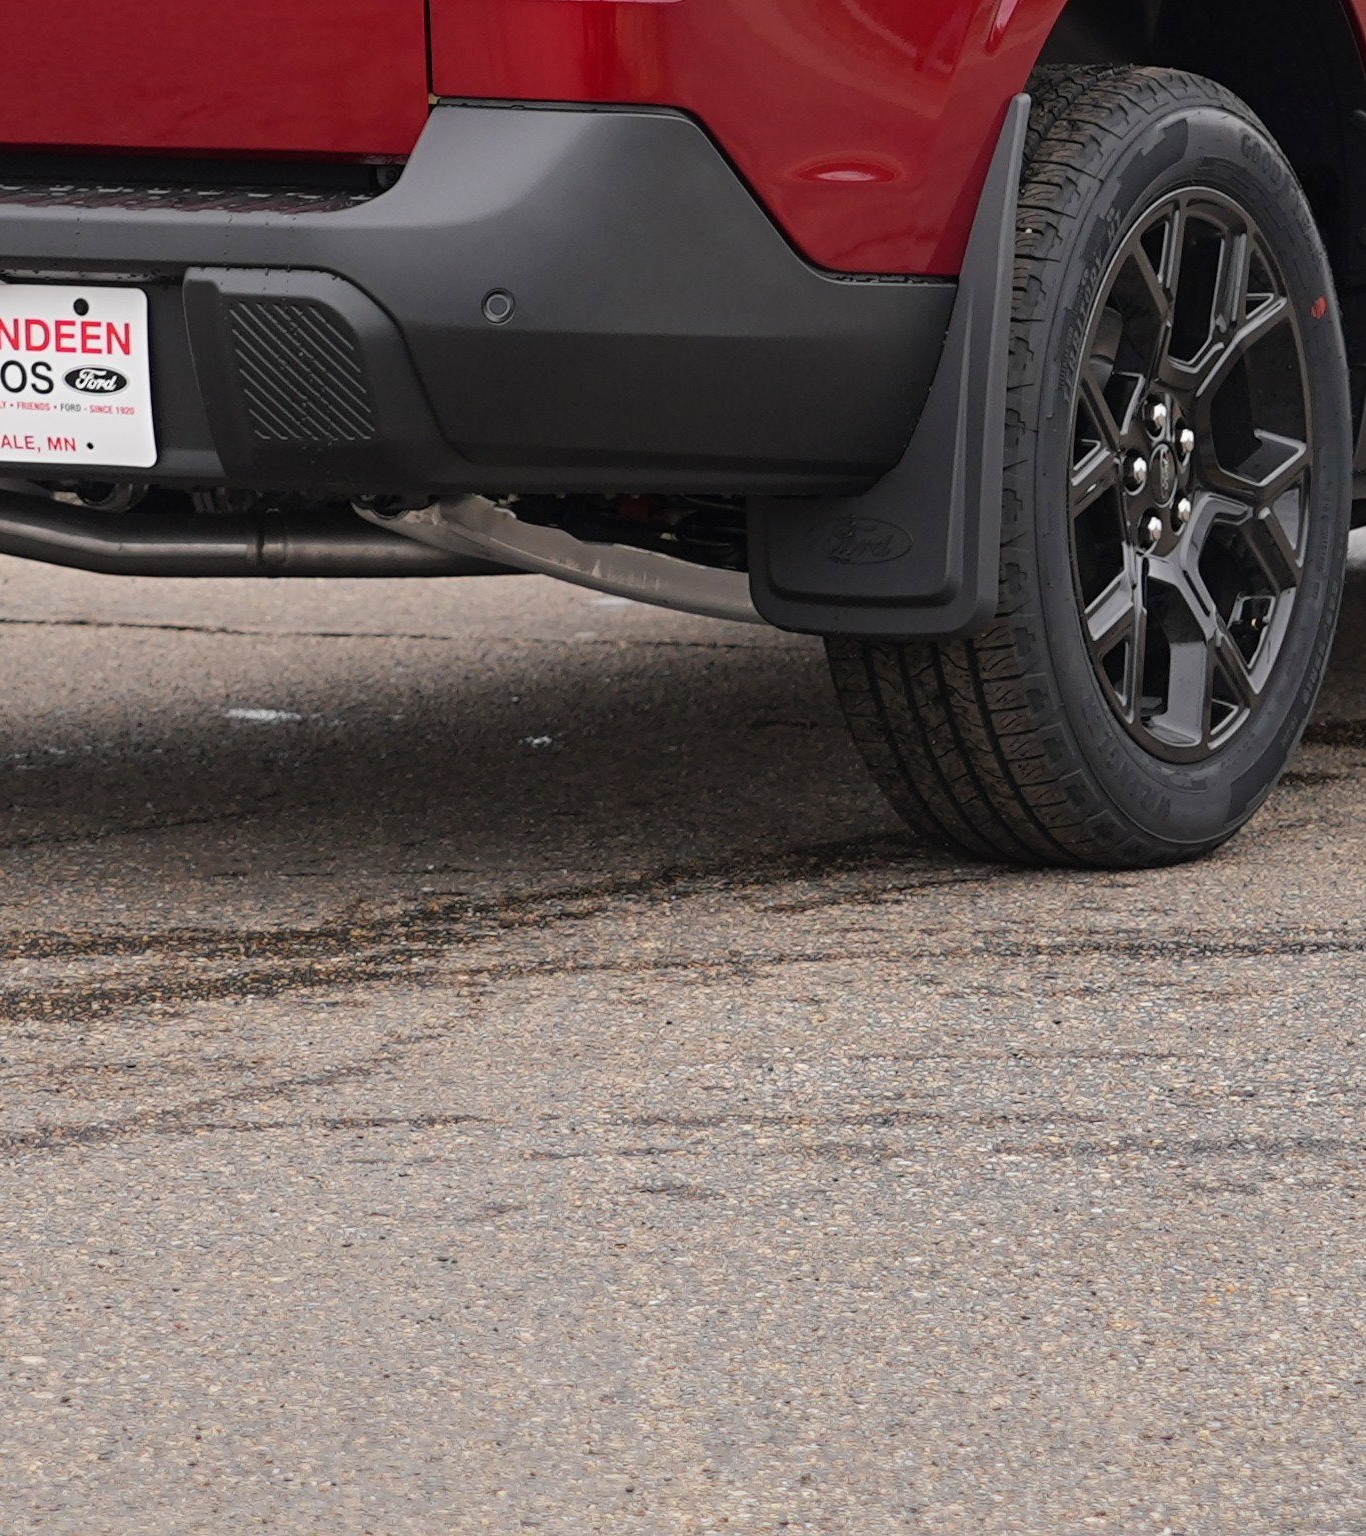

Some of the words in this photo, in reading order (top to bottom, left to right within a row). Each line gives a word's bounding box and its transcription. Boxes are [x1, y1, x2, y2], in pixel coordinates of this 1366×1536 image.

[74, 368, 117, 391] Ford
[16, 401, 51, 411] FRIENDS
[60, 402, 82, 412] FORD
[89, 404, 113, 414] SINCE
[47, 436, 77, 452] MN
